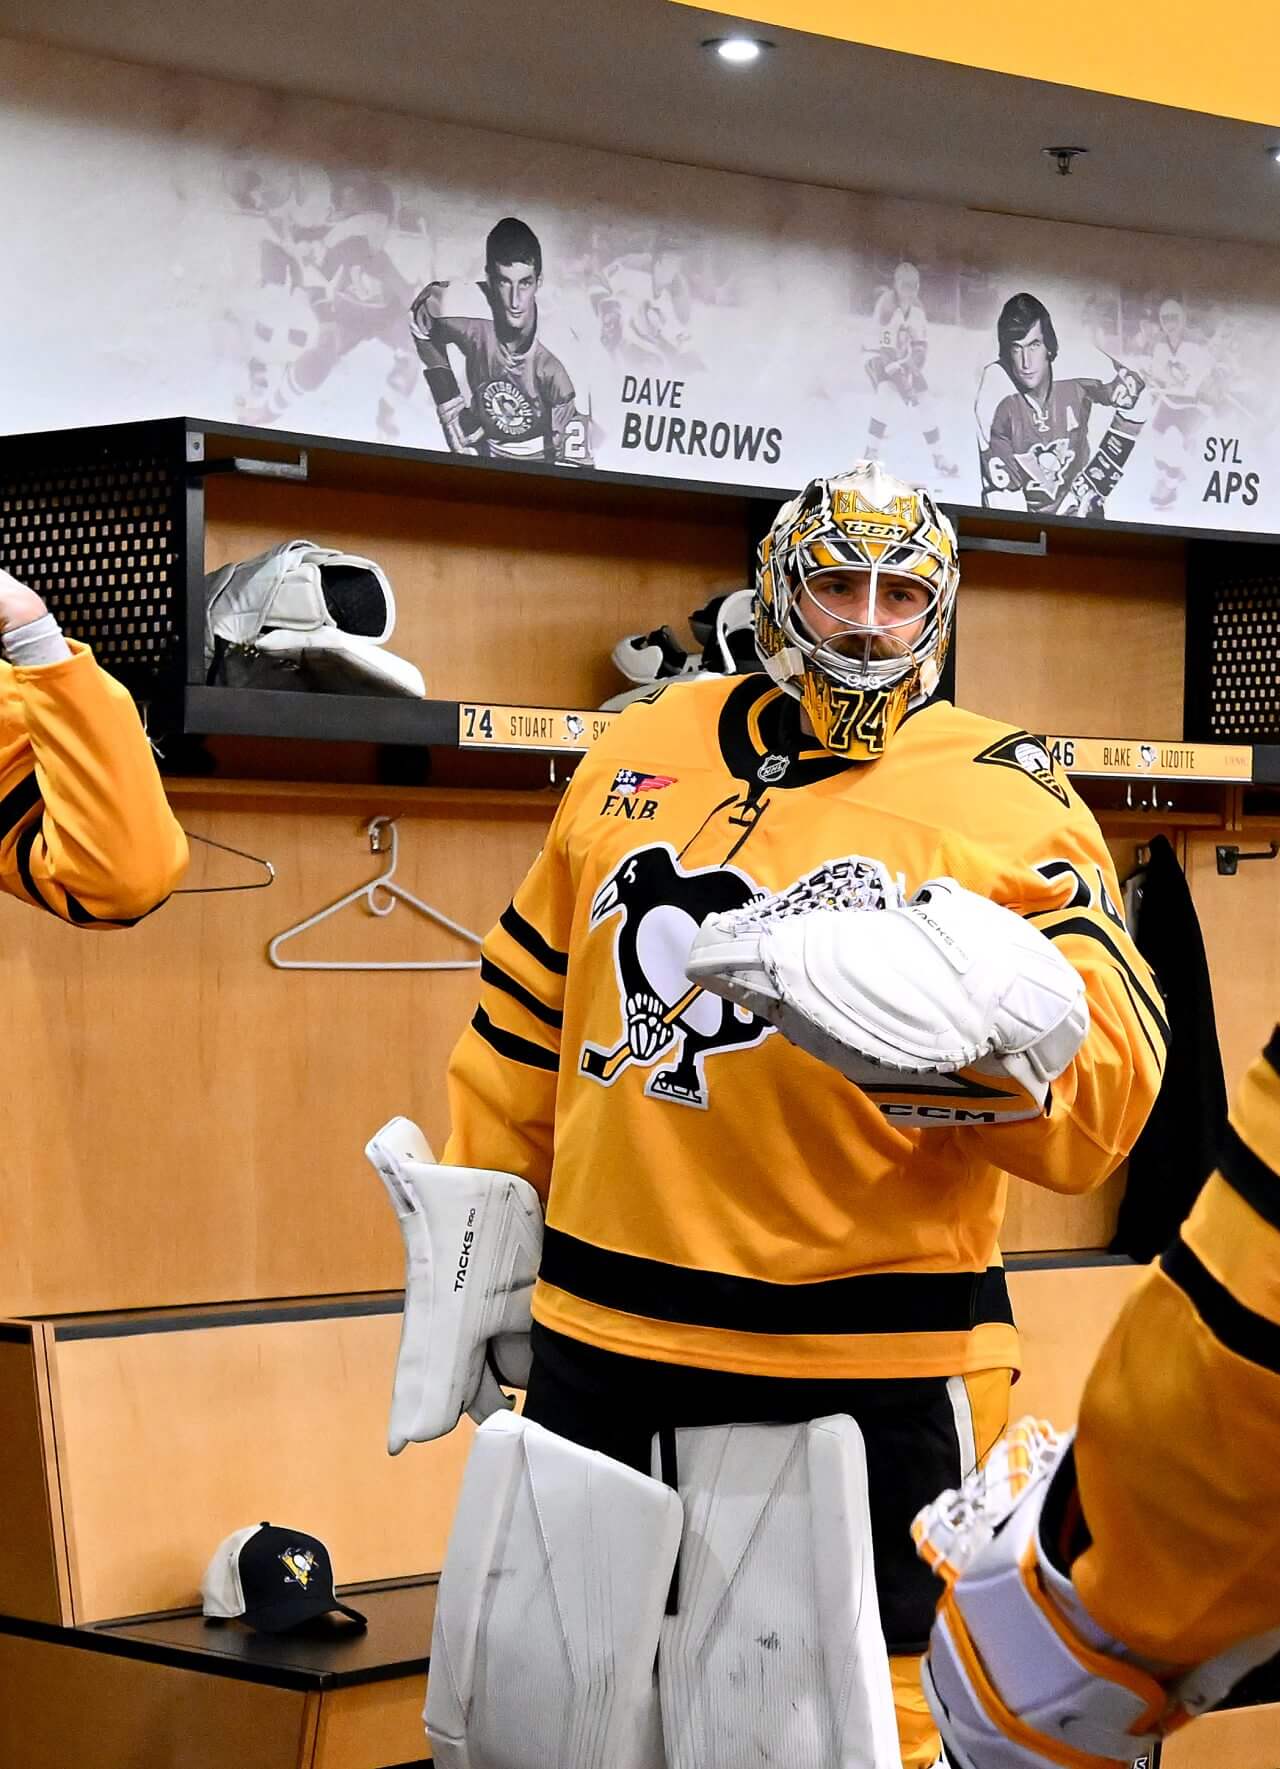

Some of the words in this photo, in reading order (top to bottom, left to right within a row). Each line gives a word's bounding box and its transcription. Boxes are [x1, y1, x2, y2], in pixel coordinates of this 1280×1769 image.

[621, 375, 685, 409] DAVE
[621, 412, 783, 465] BURROWS
[1203, 436, 1242, 464] SYL
[1202, 470, 1260, 505] APS
[844, 520, 907, 540] CCM
[463, 708, 493, 738] 74
[510, 716, 554, 738] STUART
[828, 687, 891, 753] 74
[1051, 740, 1074, 767] 46
[1103, 747, 1131, 767] BLAKE
[1160, 749, 1195, 769] LIZOTTE
[600, 795, 658, 820] F.N.B.
[911, 908, 954, 947] TACKS
[878, 1103, 996, 1123] CCM
[454, 1230, 474, 1293] TACKS
